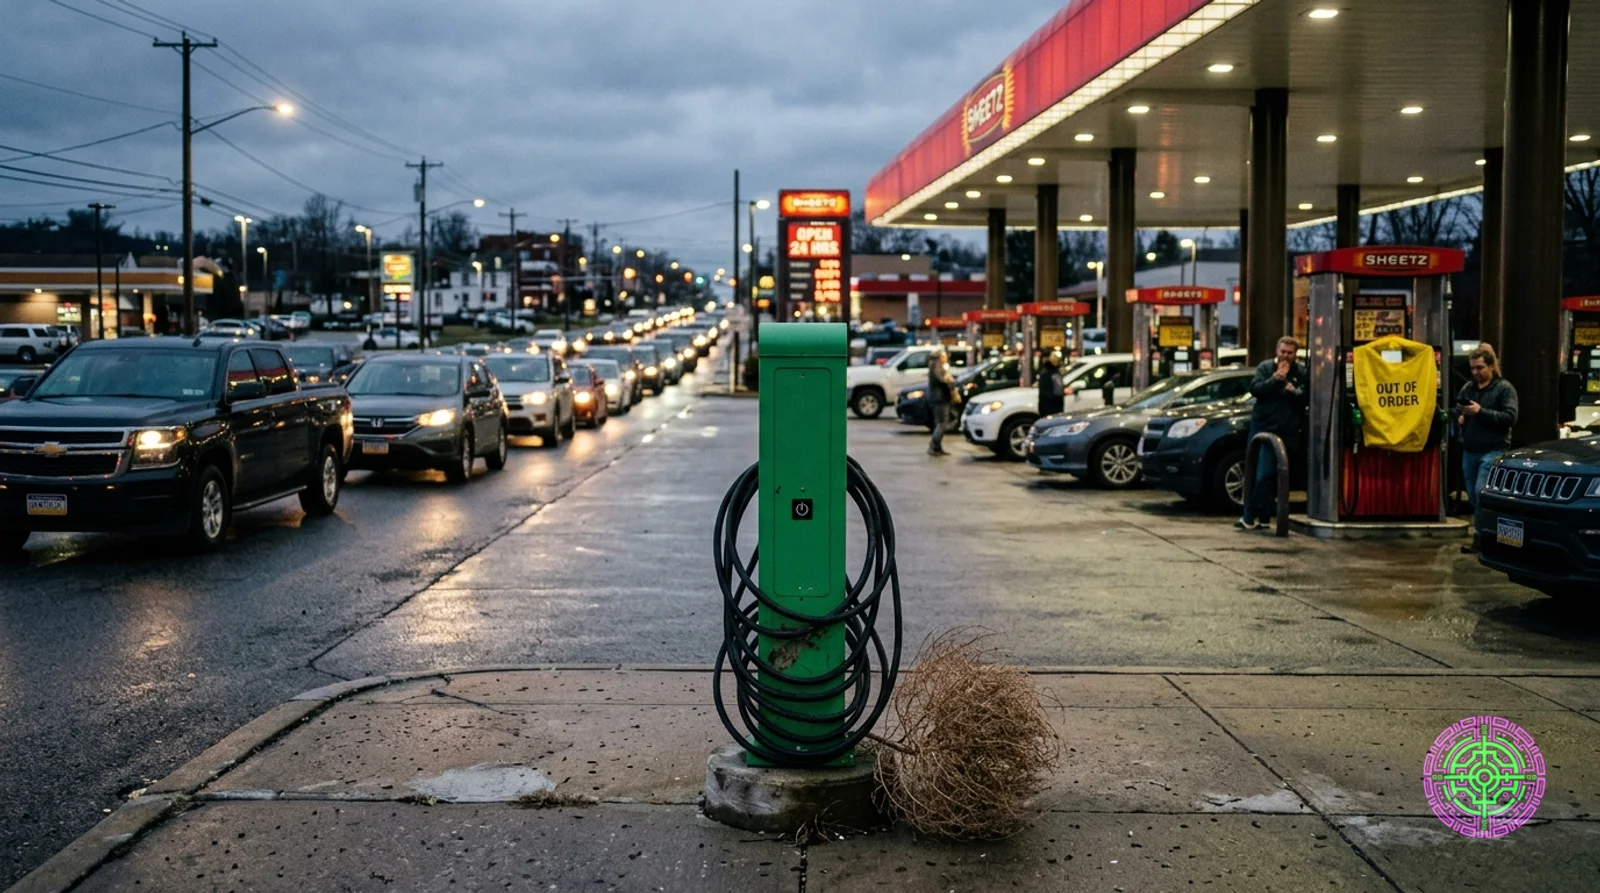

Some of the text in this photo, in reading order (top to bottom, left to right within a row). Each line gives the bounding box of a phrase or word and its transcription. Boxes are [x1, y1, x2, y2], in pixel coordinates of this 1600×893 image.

[967, 83, 1004, 133] SHEETZ
[796, 227, 833, 241] OPEN
[790, 240, 840, 256] 24 HRS
[1366, 254, 1428, 265] SHEETZ
[1376, 381, 1417, 394] OUT OF
[1378, 395, 1419, 407] ORDER
